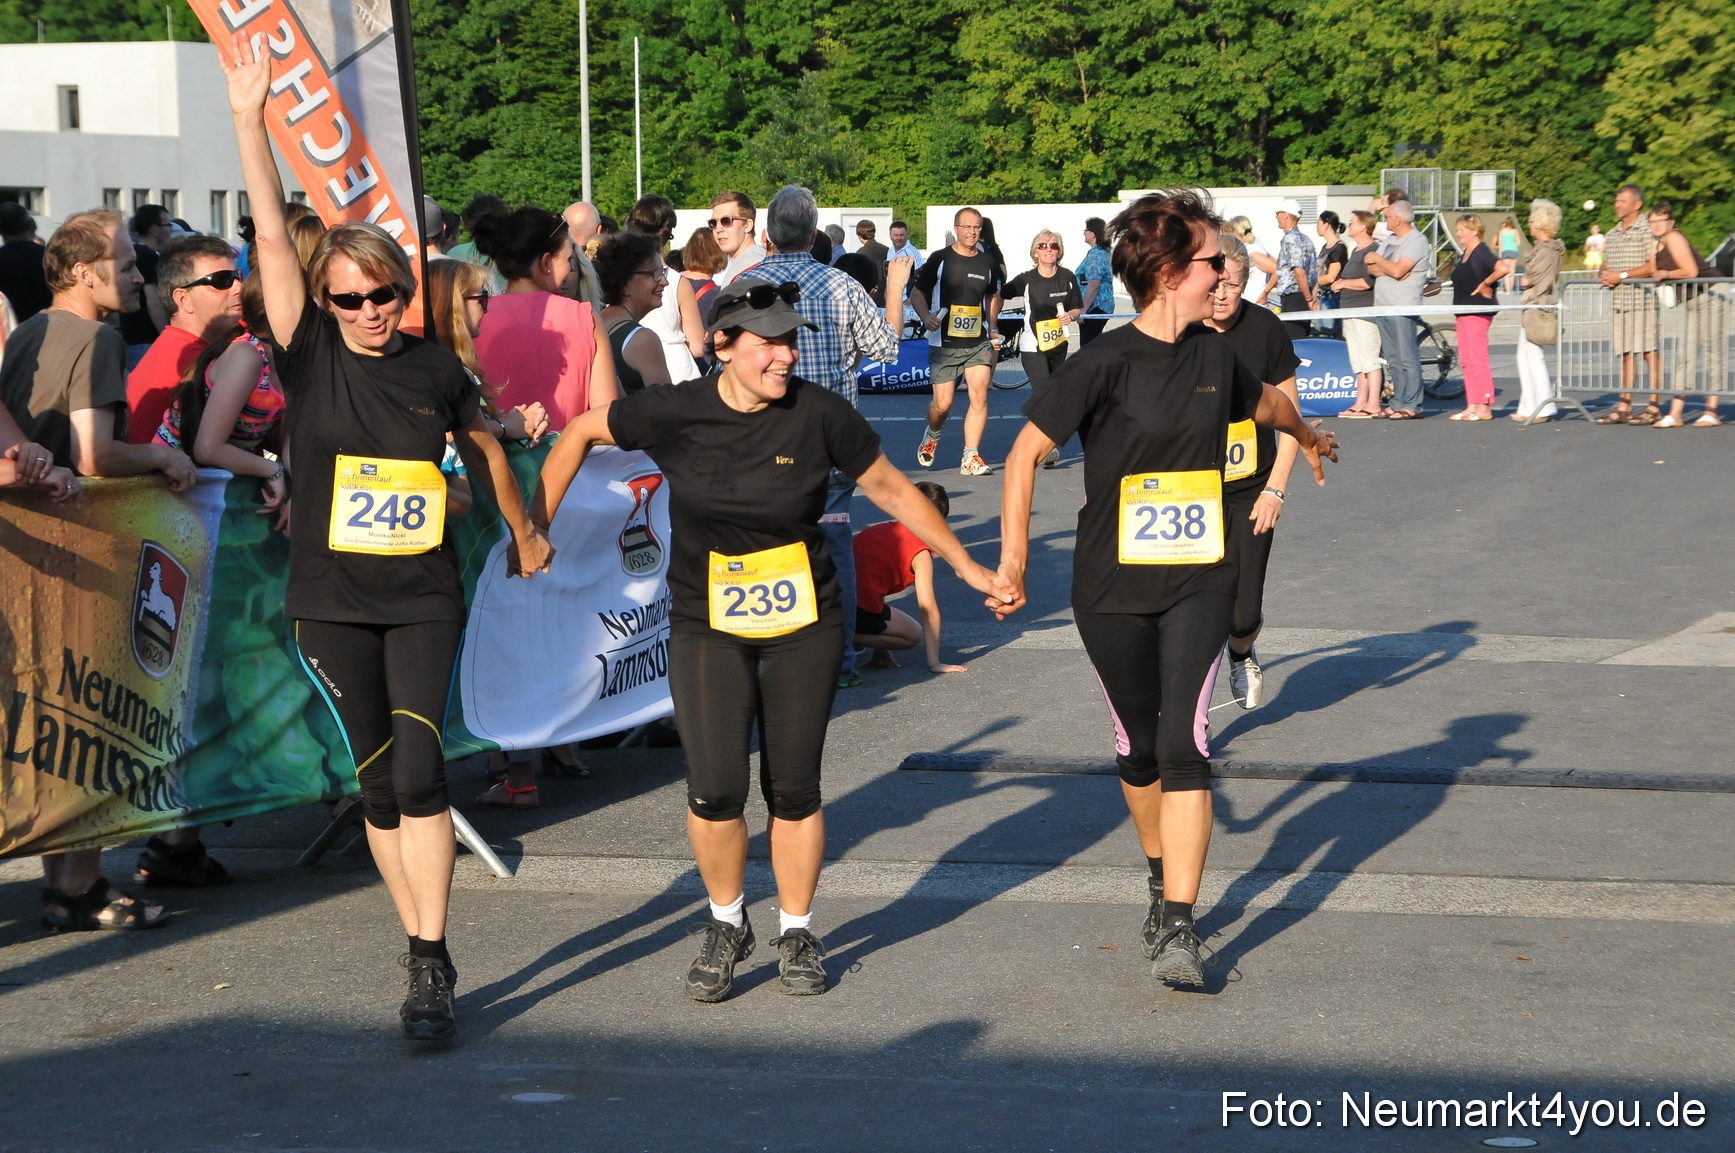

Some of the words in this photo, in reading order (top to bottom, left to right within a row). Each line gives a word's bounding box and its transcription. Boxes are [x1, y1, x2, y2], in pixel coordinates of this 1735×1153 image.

[954, 316, 978, 330] 987
[1043, 326, 1064, 342] 985
[1296, 372, 1359, 391] sche
[776, 455, 794, 465] Vera
[346, 491, 427, 531] 248
[1134, 504, 1206, 541] 238
[628, 551, 655, 571] 1628
[723, 579, 797, 617] 239
[141, 639, 165, 668] 1628
